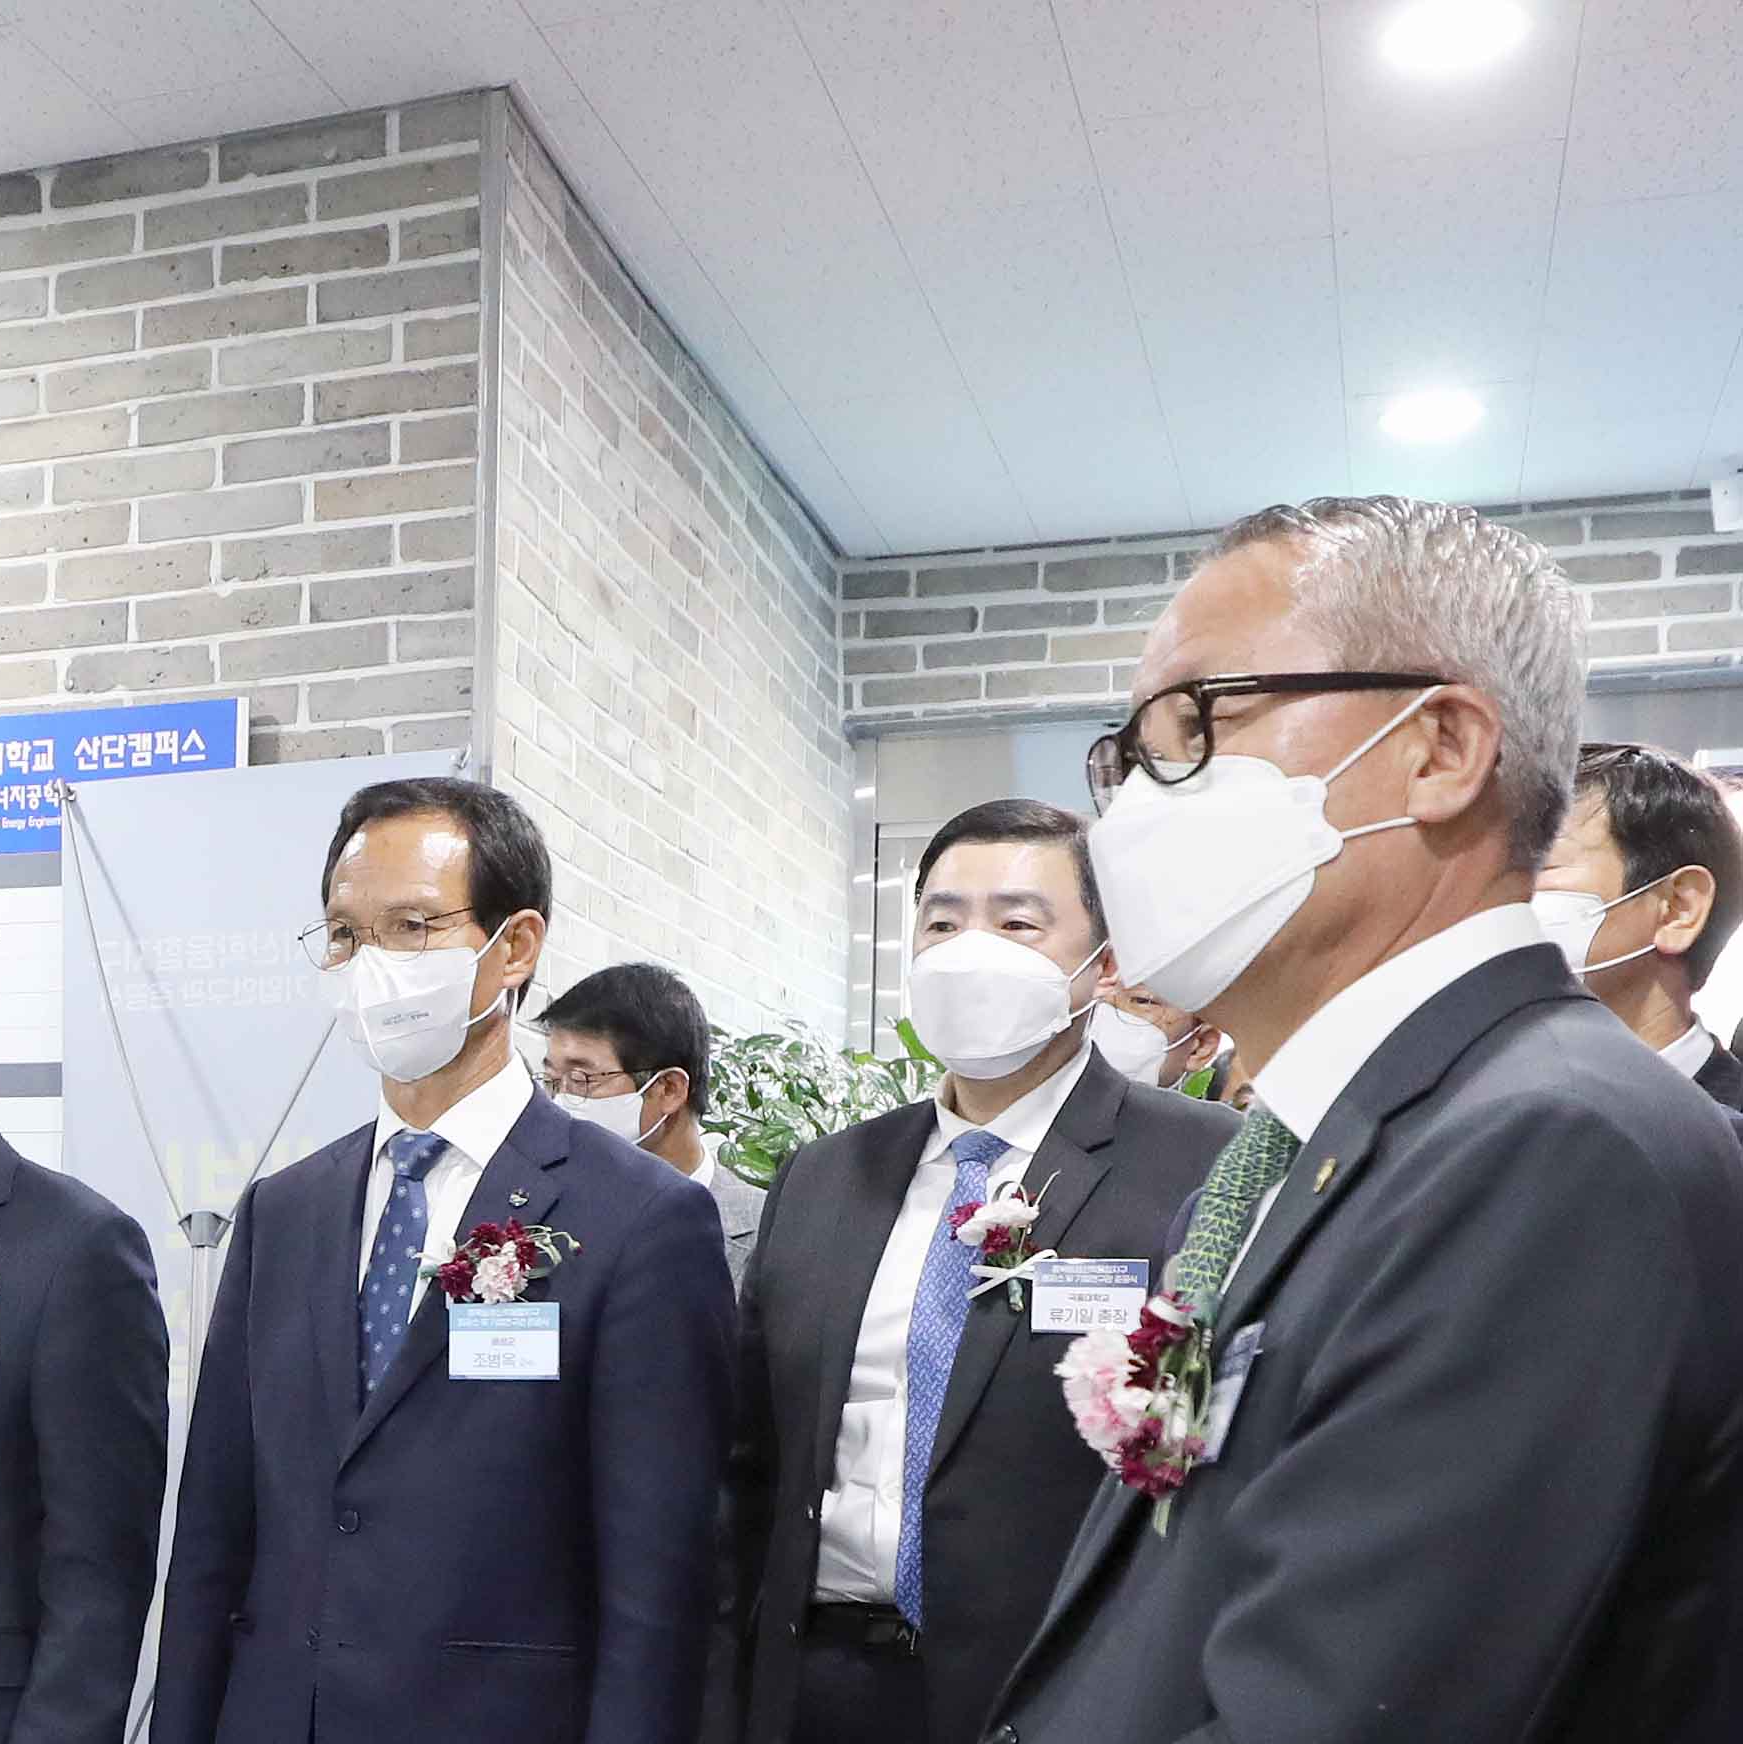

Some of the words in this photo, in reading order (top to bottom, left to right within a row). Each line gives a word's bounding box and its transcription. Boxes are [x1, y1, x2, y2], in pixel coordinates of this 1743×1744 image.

[74, 729, 207, 771] 산단캠퍼스
[1050, 1307, 1093, 1325] 류기일
[1098, 1307, 1128, 1324] 총장
